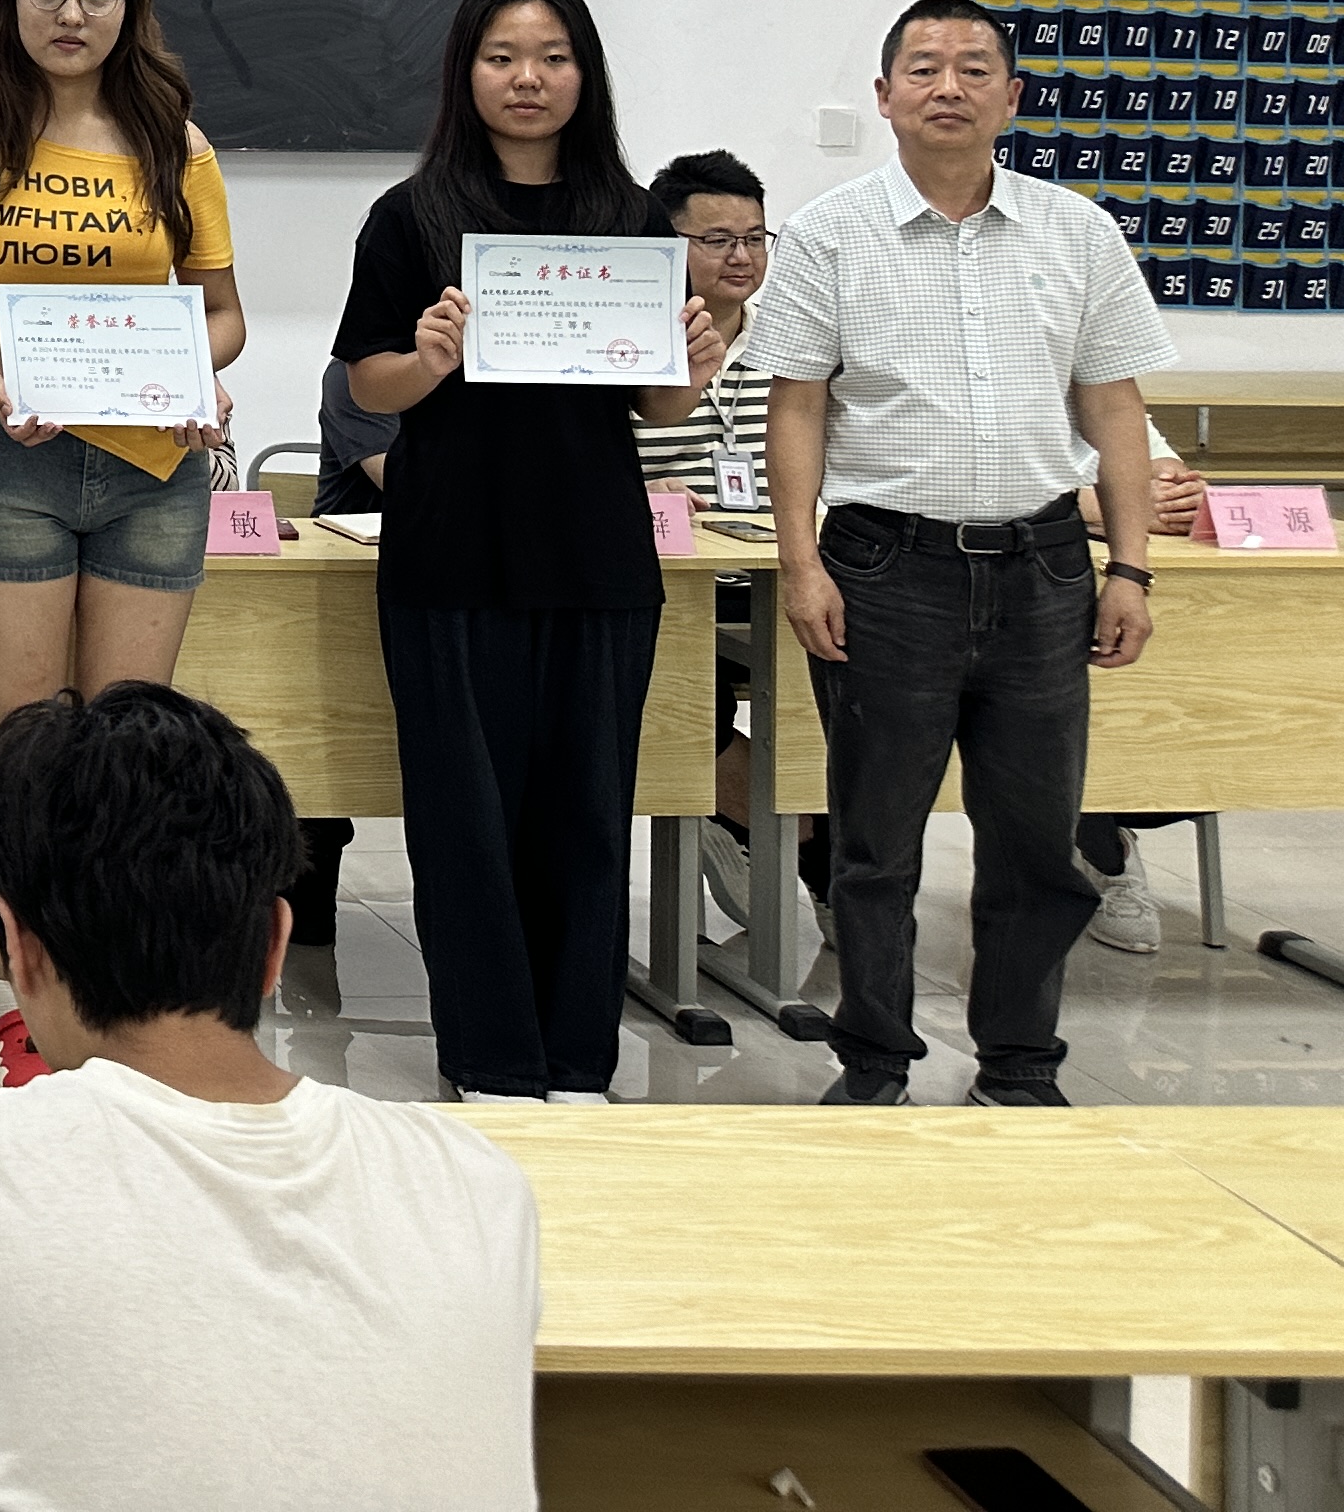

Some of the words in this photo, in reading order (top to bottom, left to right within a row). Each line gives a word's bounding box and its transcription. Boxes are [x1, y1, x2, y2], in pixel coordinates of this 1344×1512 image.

[1000, 23, 1015, 35] 7
[1035, 24, 1058, 43] 08
[1079, 25, 1101, 45] 09
[1127, 27, 1148, 46] 10
[1173, 29, 1195, 48] 11
[1216, 29, 1239, 49] 12
[1263, 32, 1285, 51] 07
[1307, 34, 1330, 54] 08
[1038, 88, 1059, 107] 14
[1082, 90, 1104, 108] 15
[1127, 92, 1148, 110] 16
[1169, 92, 1192, 110] 17
[1215, 91, 1237, 109] 18
[1264, 95, 1286, 113] 13
[1308, 95, 1329, 114] 14
[1032, 149, 1055, 167] 20
[1077, 150, 1100, 169] 21
[1121, 152, 1145, 171] 22
[1167, 154, 1192, 173] 23
[1211, 156, 1235, 175] 24
[1264, 156, 1284, 175] 19
[1307, 156, 1329, 175] 20
[1118, 216, 1141, 234] 28
[1161, 217, 1186, 235] 29
[1205, 216, 1231, 235] 30
[1258, 222, 1283, 240] 25
[1301, 220, 1326, 239] 26
[536, 263, 612, 281] 荣誉证书
[1163, 275, 1186, 295] 35
[1207, 278, 1233, 297] 36
[1262, 280, 1285, 299] 31
[1305, 279, 1327, 299] 32
[67, 313, 137, 329] 荣誉证书
[230, 510, 261, 538] 敏
[1224, 506, 1314, 533] 马源
